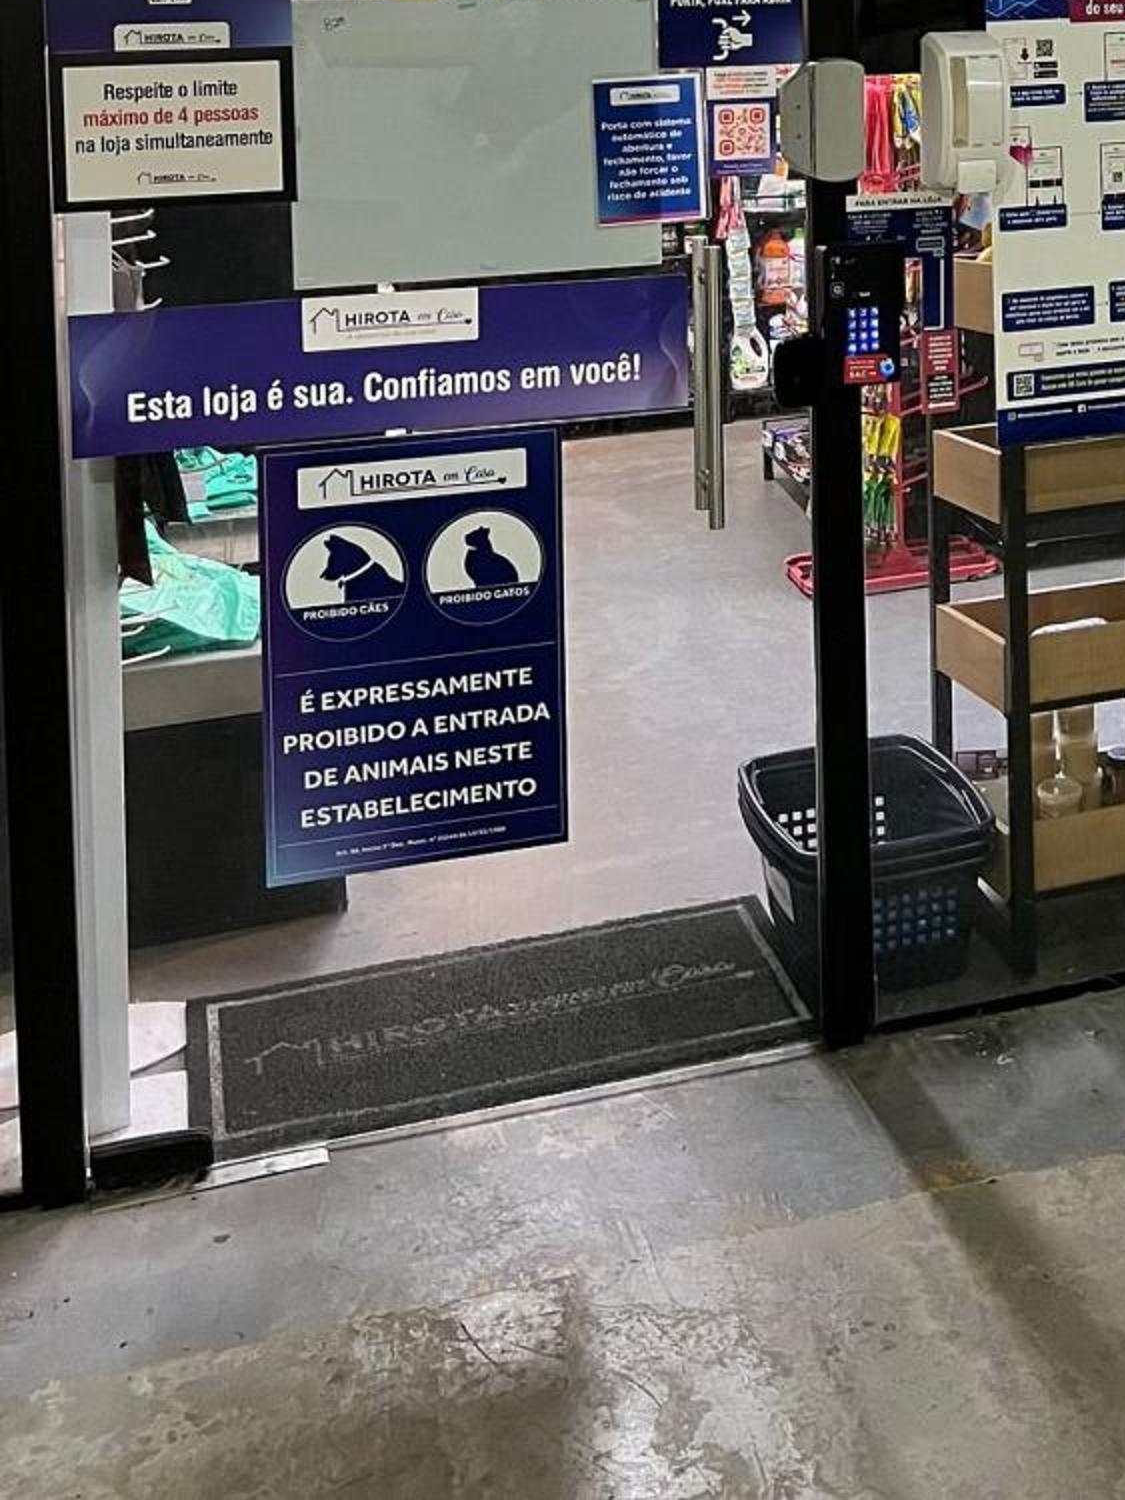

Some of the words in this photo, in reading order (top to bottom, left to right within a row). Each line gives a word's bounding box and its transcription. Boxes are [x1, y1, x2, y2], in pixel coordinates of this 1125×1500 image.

[1085, 2, 1101, 16] do
[1103, 2, 1125, 15] seu
[103, 82, 173, 103] Respeite
[178, 87, 188, 97] o
[192, 79, 238, 97] limite
[83, 109, 149, 128] máximo
[153, 109, 173, 124] de
[178, 108, 188, 123] 4
[193, 106, 259, 126] pessoas
[601, 121, 628, 131] Porta
[630, 121, 652, 129] com
[654, 118, 692, 128] sistema
[75, 140, 95, 154] na
[100, 135, 131, 154] loja
[135, 130, 273, 152] simultaneamente
[671, 165, 679, 173] o
[345, 310, 411, 327] HIROTA
[127, 392, 192, 423] Esta
[203, 385, 256, 420] loja
[268, 380, 283, 409] é
[294, 383, 353, 408] sua.
[364, 363, 511, 405] Confiamos
[521, 363, 560, 389] em
[570, 353, 641, 385] você!
[360, 469, 437, 491] HIROTA
[438, 591, 492, 605] PROIBIDO
[494, 585, 530, 598] GATOS
[303, 605, 358, 621] PROIBIDO
[359, 601, 389, 615] CÃES
[300, 688, 315, 714] É
[322, 667, 533, 711] EXPRESSAMENTE
[284, 722, 405, 754] PROIBIDO
[411, 718, 429, 737] A
[434, 702, 551, 734] ENTRADA
[305, 768, 338, 790] DE
[344, 752, 449, 786] ANIMAIS
[455, 742, 532, 767] NESTE
[301, 777, 537, 828] ESTABELECIMENTO
